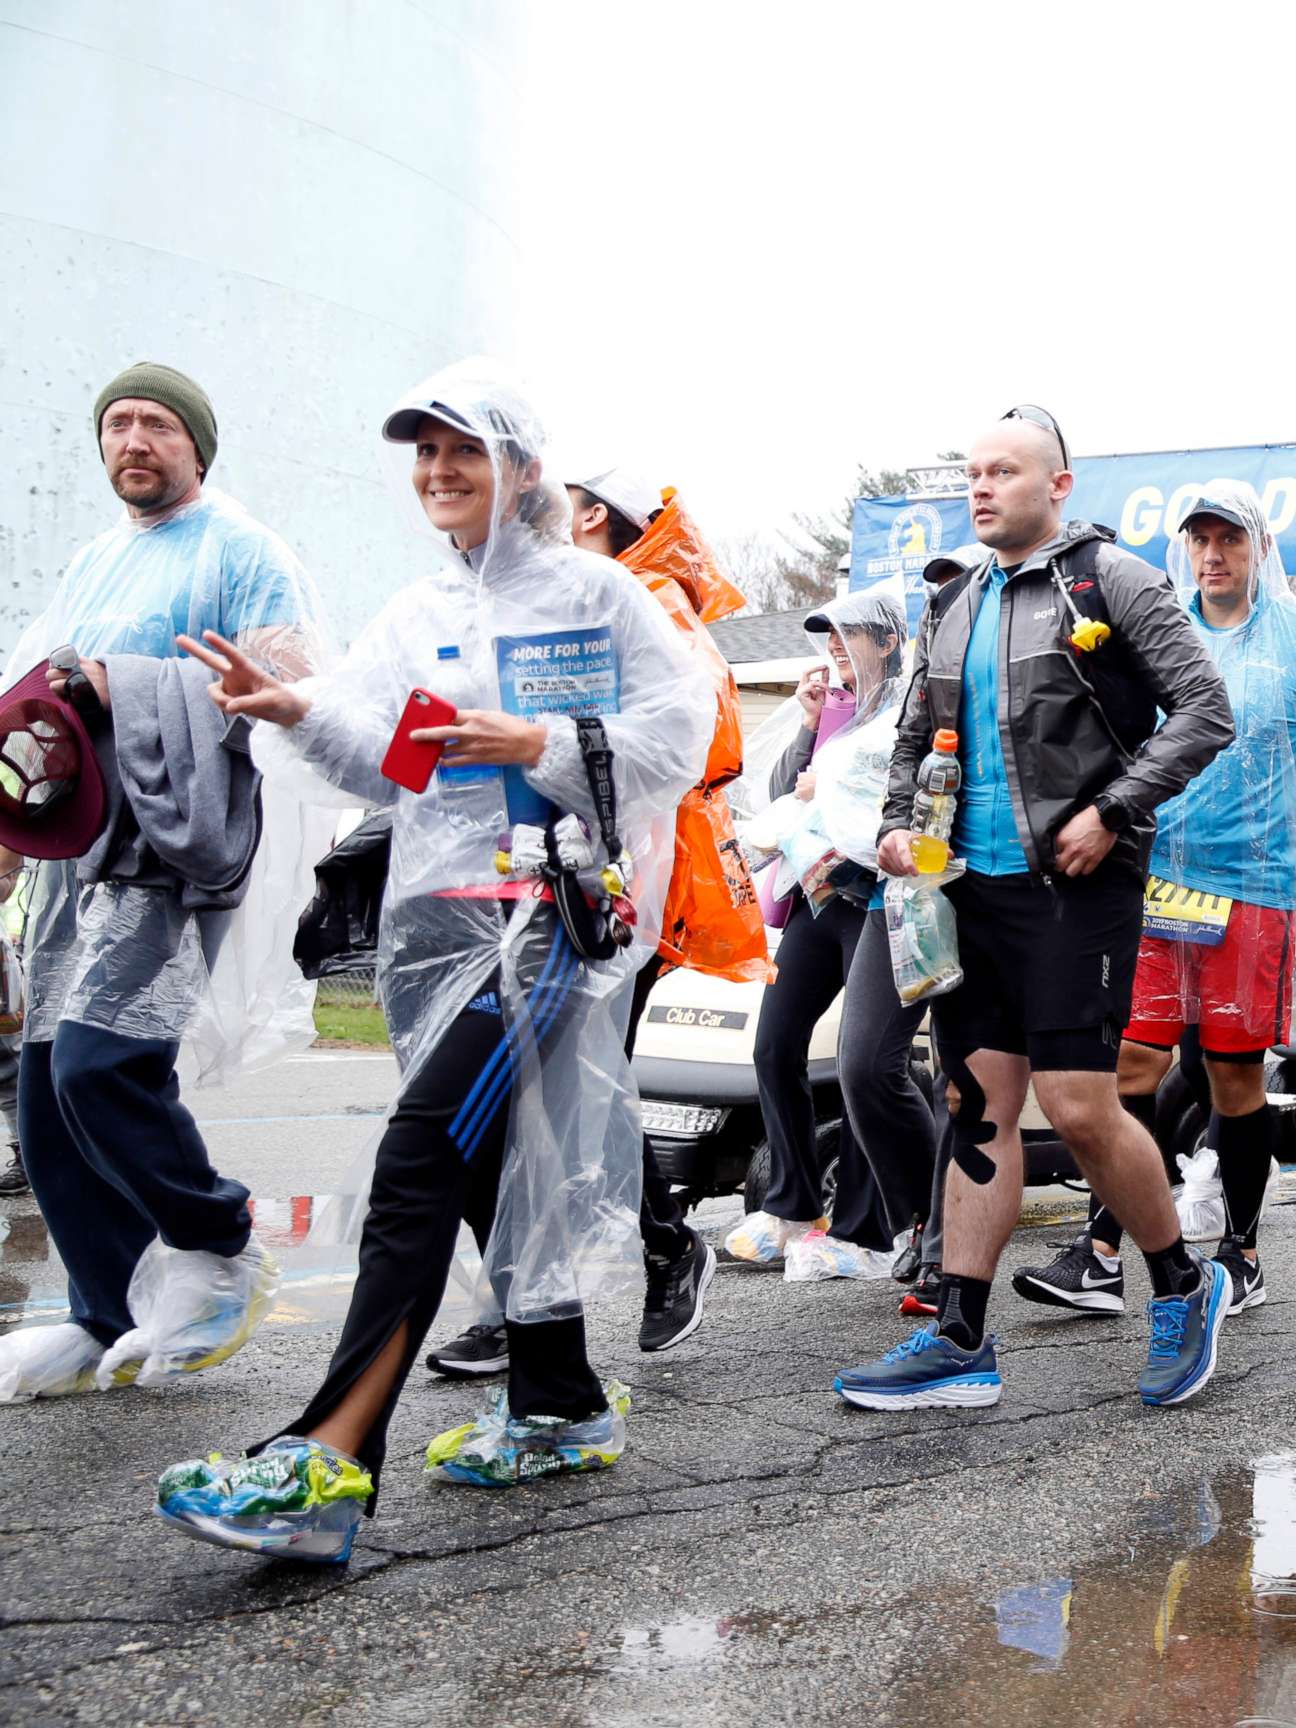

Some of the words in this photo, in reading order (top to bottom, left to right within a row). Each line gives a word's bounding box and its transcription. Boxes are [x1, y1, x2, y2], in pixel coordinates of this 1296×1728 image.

[513, 645, 552, 661] MORE
[554, 643, 580, 658] FOR
[584, 638, 611, 654] YOUR
[515, 662, 560, 677] setting
[562, 660, 584, 672] the
[586, 656, 612, 673] pace
[594, 750, 614, 833] SPIBEL
[1151, 922, 1189, 933] MARATHON
[666, 1008, 695, 1024] Club
[699, 1010, 726, 1027] Car
